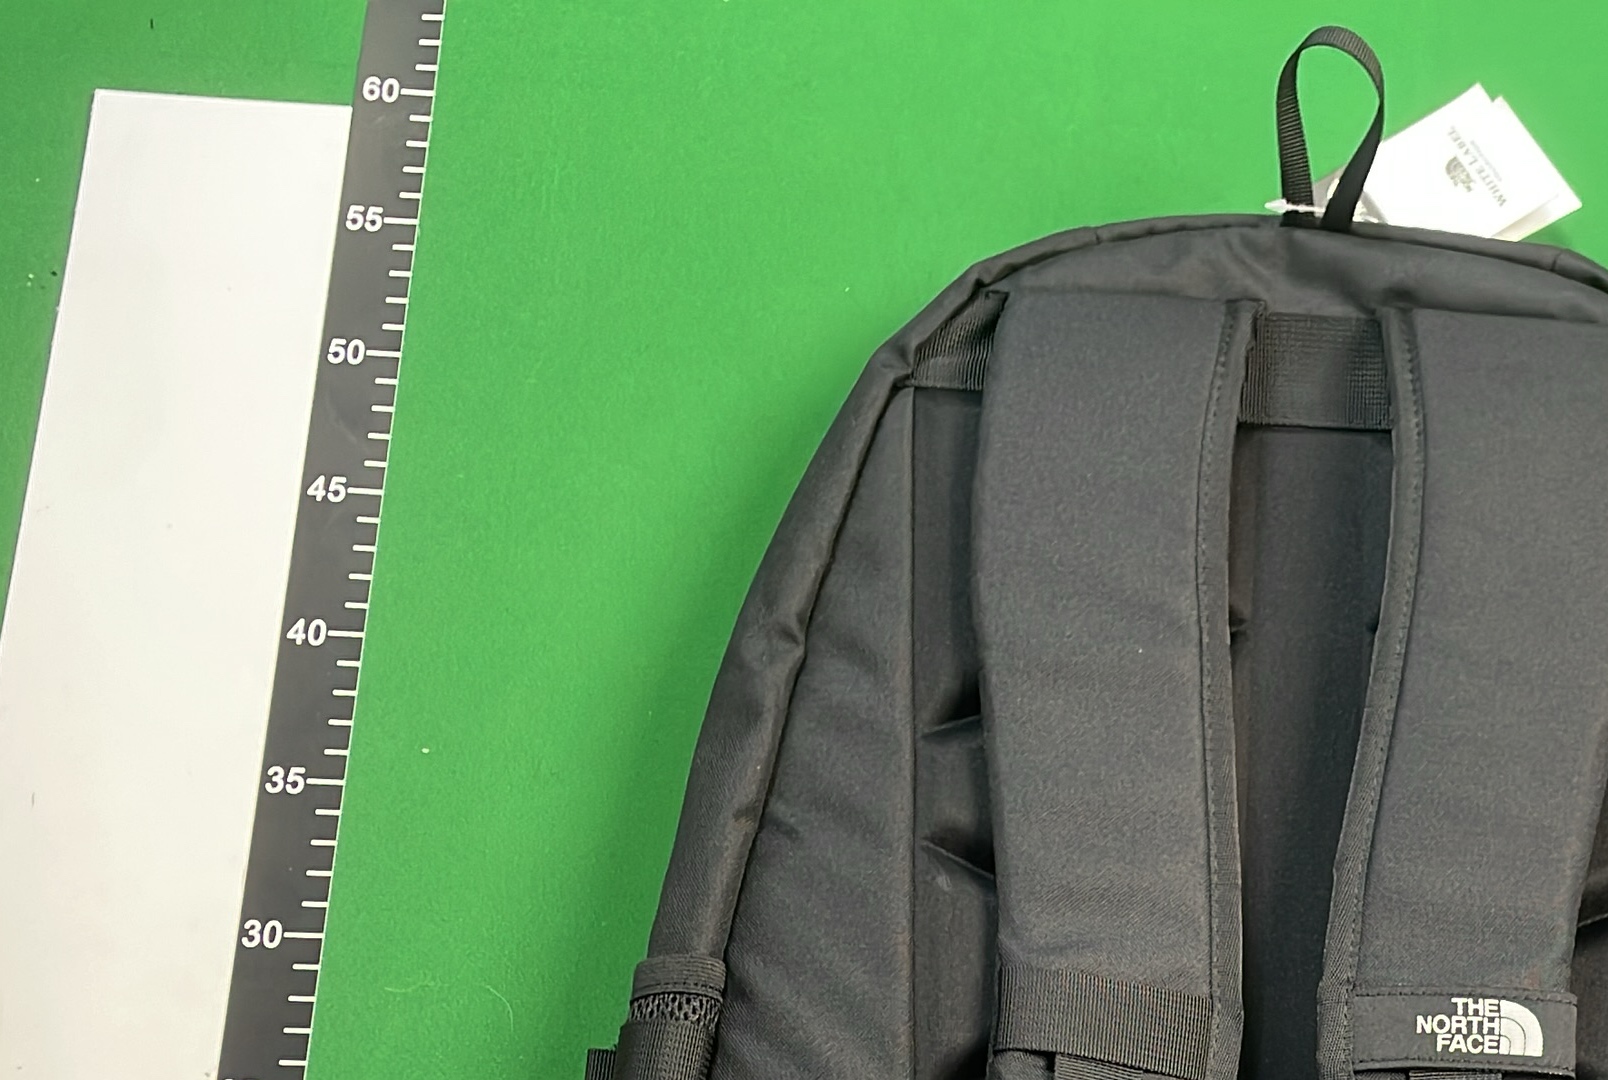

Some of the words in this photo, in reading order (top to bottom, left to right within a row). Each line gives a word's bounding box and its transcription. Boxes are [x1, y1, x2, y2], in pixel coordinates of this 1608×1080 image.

[362, 75, 400, 103] 60
[345, 204, 384, 232] 55
[326, 337, 366, 366] 50
[306, 474, 348, 503] 45
[285, 617, 328, 647] 40
[264, 765, 307, 795] 35
[240, 918, 283, 949] 30
[1451, 997, 1500, 1017] THE
[1416, 1014, 1500, 1036] NORTH
[1436, 1034, 1500, 1054] FACE
